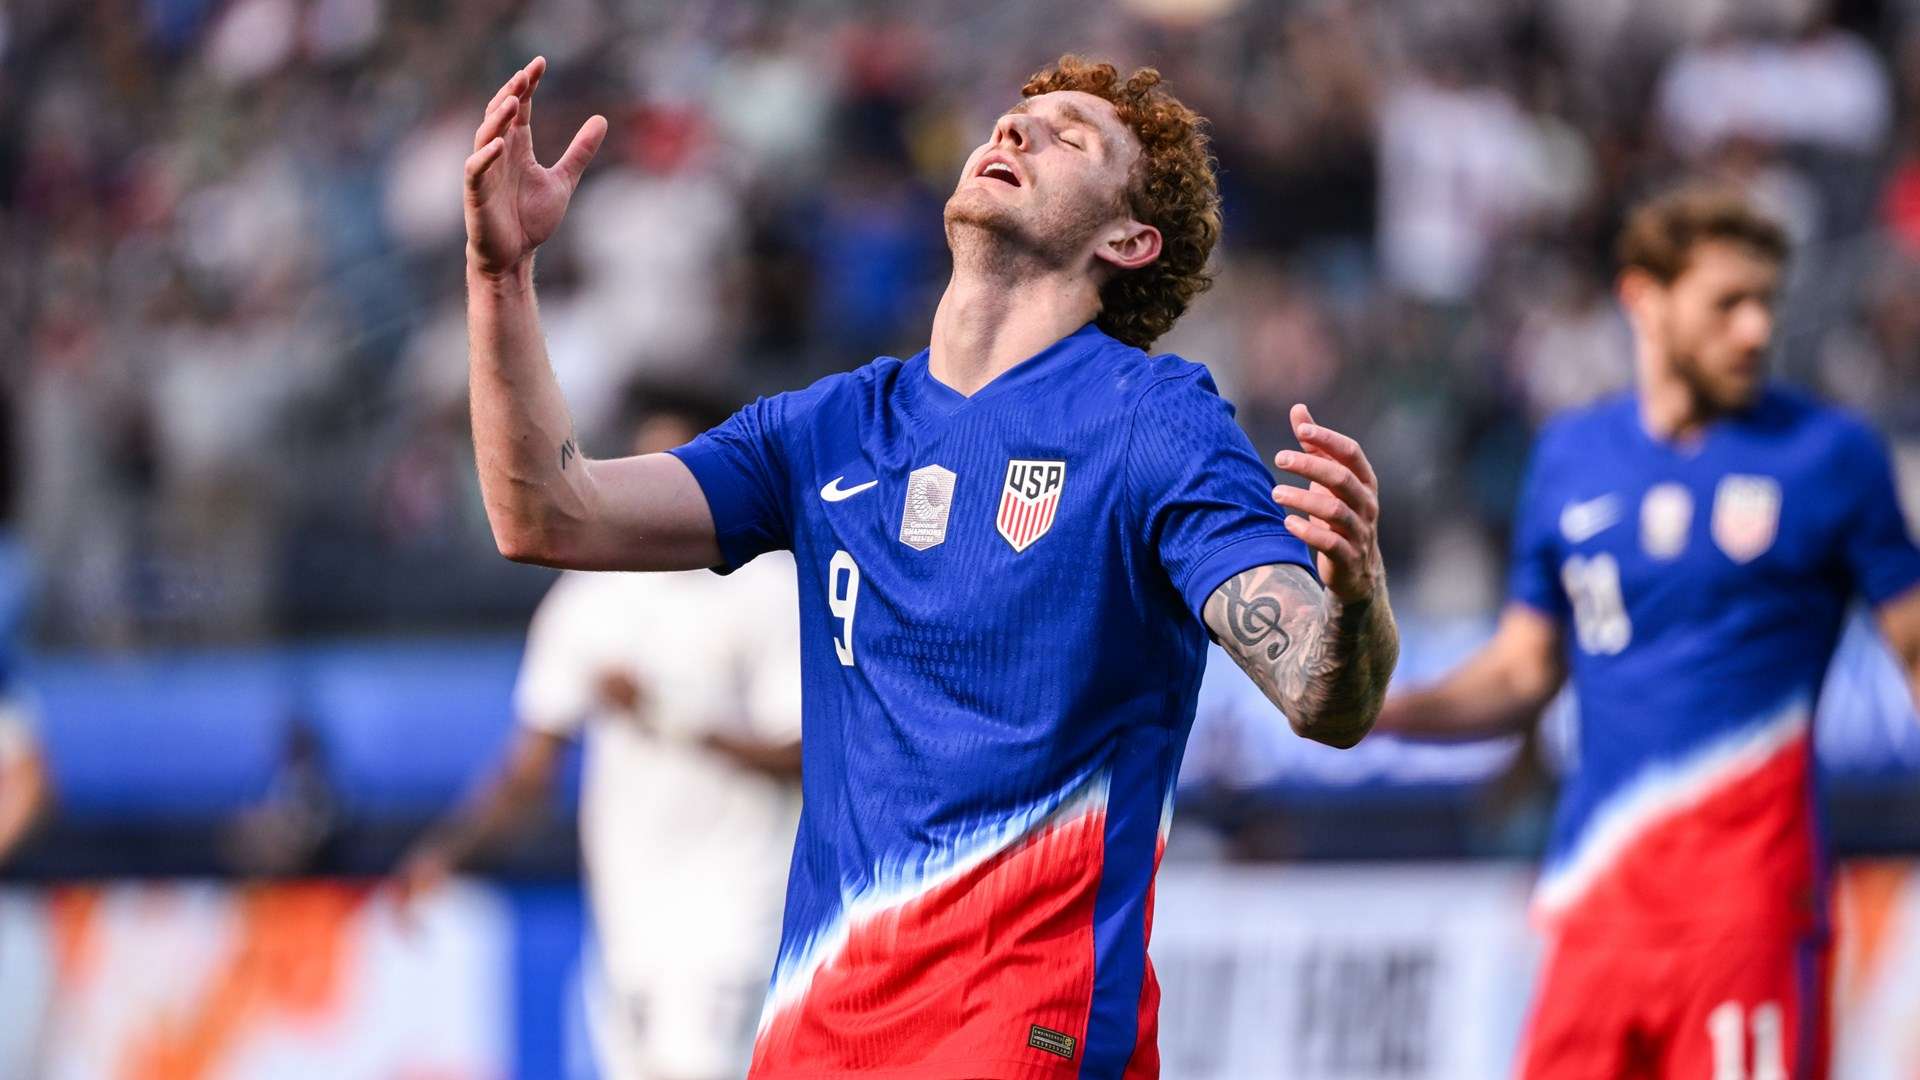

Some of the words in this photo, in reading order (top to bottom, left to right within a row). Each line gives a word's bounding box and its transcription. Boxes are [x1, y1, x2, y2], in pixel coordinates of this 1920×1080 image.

[1010, 465, 1061, 500] USA
[828, 550, 860, 667] 9
[1704, 999, 1790, 1080] 11
